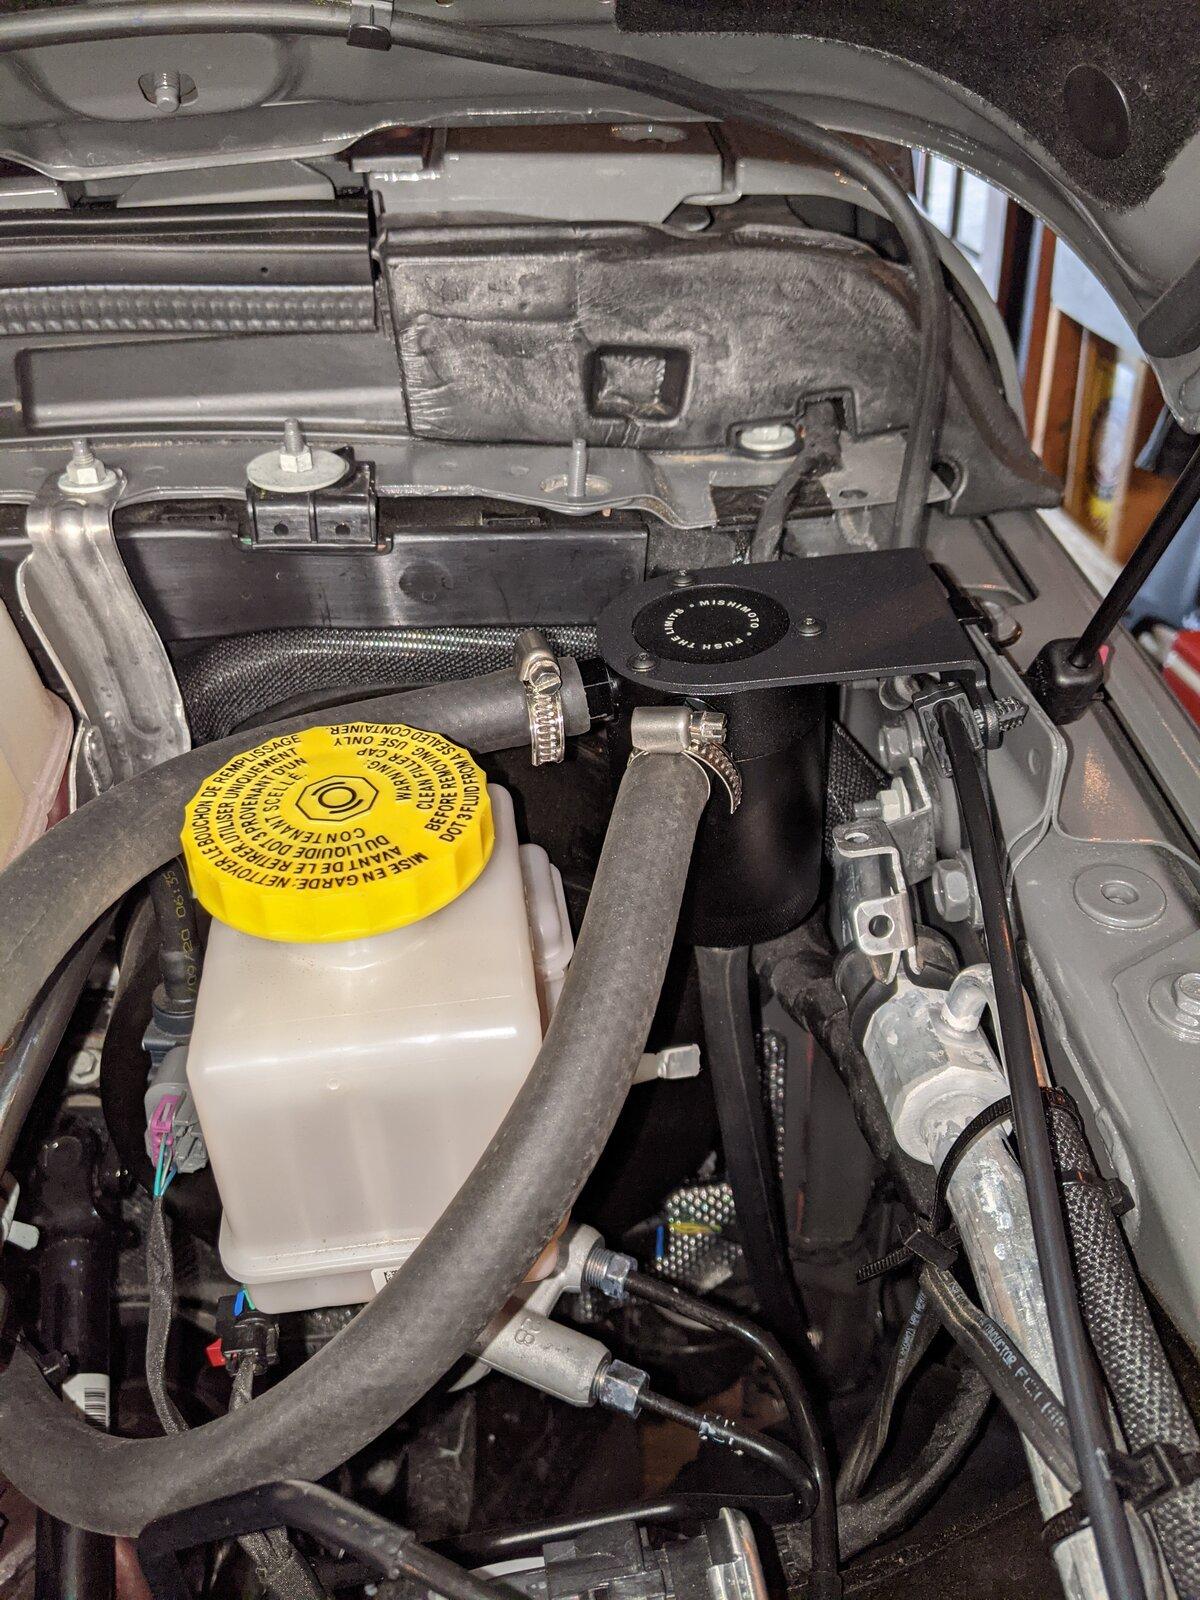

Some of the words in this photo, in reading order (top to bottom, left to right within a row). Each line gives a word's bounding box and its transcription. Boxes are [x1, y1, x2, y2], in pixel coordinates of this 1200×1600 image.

[664, 608, 684, 635] LIMITS
[699, 600, 760, 629] MISHIMOTO
[671, 635, 696, 649] THE
[702, 638, 744, 650] PUSH
[334, 736, 374, 746] ONLY
[377, 738, 408, 750] USE
[411, 731, 456, 755] SEALED
[213, 734, 301, 784] REMPLISSAGE
[356, 748, 388, 758] CAP
[450, 752, 465, 761] A
[223, 748, 298, 799] UNIQUEMENT
[271, 757, 308, 775] D'UN
[388, 753, 429, 779] FILLER
[454, 759, 477, 785] FROM
[201, 786, 222, 798] DE
[416, 778, 436, 810] CLEAN
[460, 785, 480, 812] FLUID
[239, 775, 276, 834] PROVENANT
[424, 792, 458, 831] BEFORE
[192, 800, 215, 848] BOUCHON
[216, 801, 240, 844] UTILISER
[264, 815, 365, 844] CONTENANT
[439, 821, 467, 842] DOT
[251, 831, 268, 841] 3
[258, 838, 293, 856] DOT
[365, 835, 390, 851] DU
[202, 845, 224, 860] LE
[293, 843, 363, 860] LIQUIDE
[348, 846, 402, 871] AVANT
[214, 856, 291, 888] NETTOYER
[293, 863, 317, 874] LE
[320, 861, 344, 874] DE
[388, 852, 429, 875] MISE
[362, 867, 387, 883] EN
